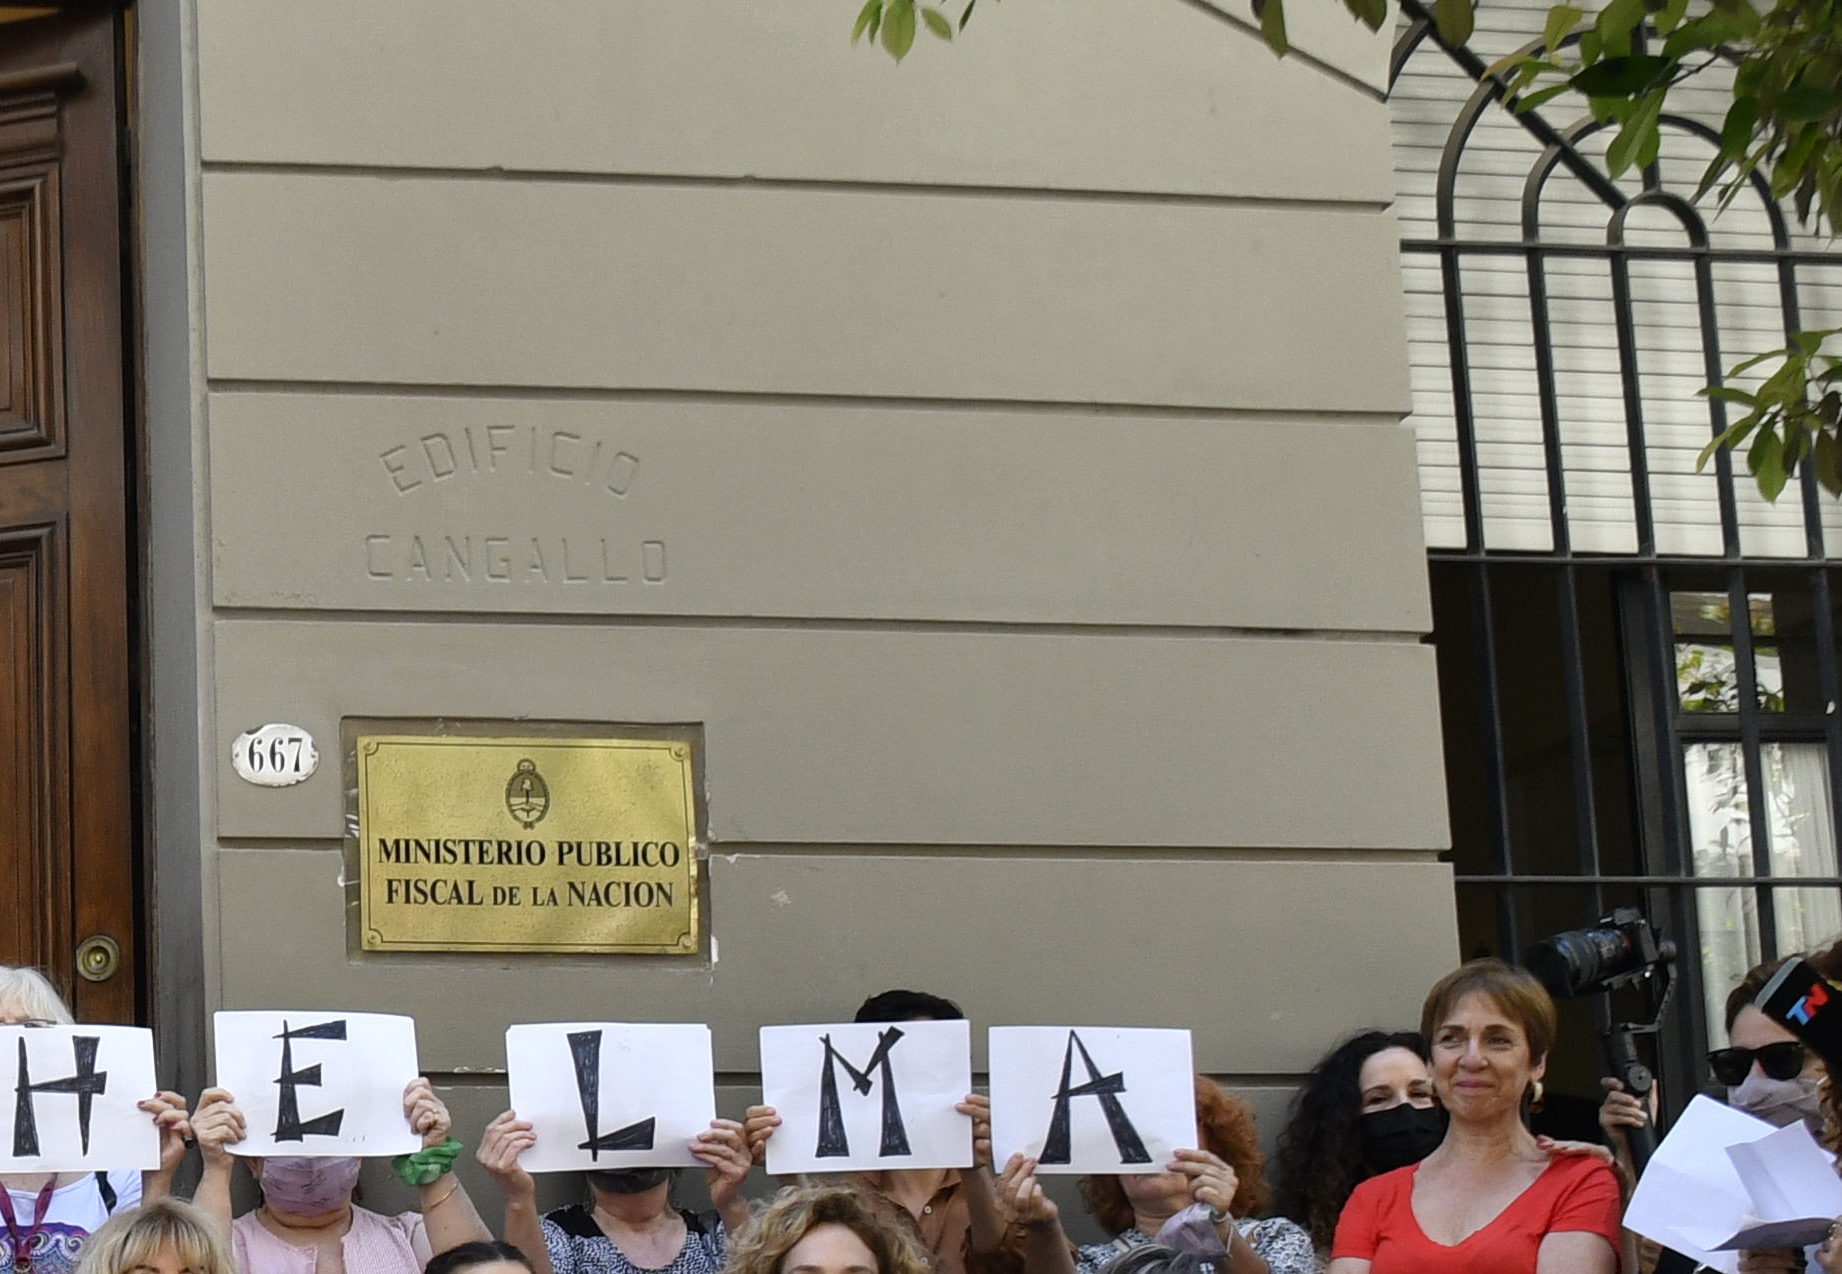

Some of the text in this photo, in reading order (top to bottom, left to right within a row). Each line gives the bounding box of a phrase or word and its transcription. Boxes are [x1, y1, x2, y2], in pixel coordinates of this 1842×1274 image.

[379, 425, 640, 497] EDIFICIO
[364, 534, 669, 584] CANGALLO
[247, 737, 303, 774] 667
[377, 838, 680, 868] MINISTERIO PUBLICO
[386, 878, 484, 907] FISCAL
[567, 880, 674, 909] NACION
[1786, 983, 1828, 1026] TN
